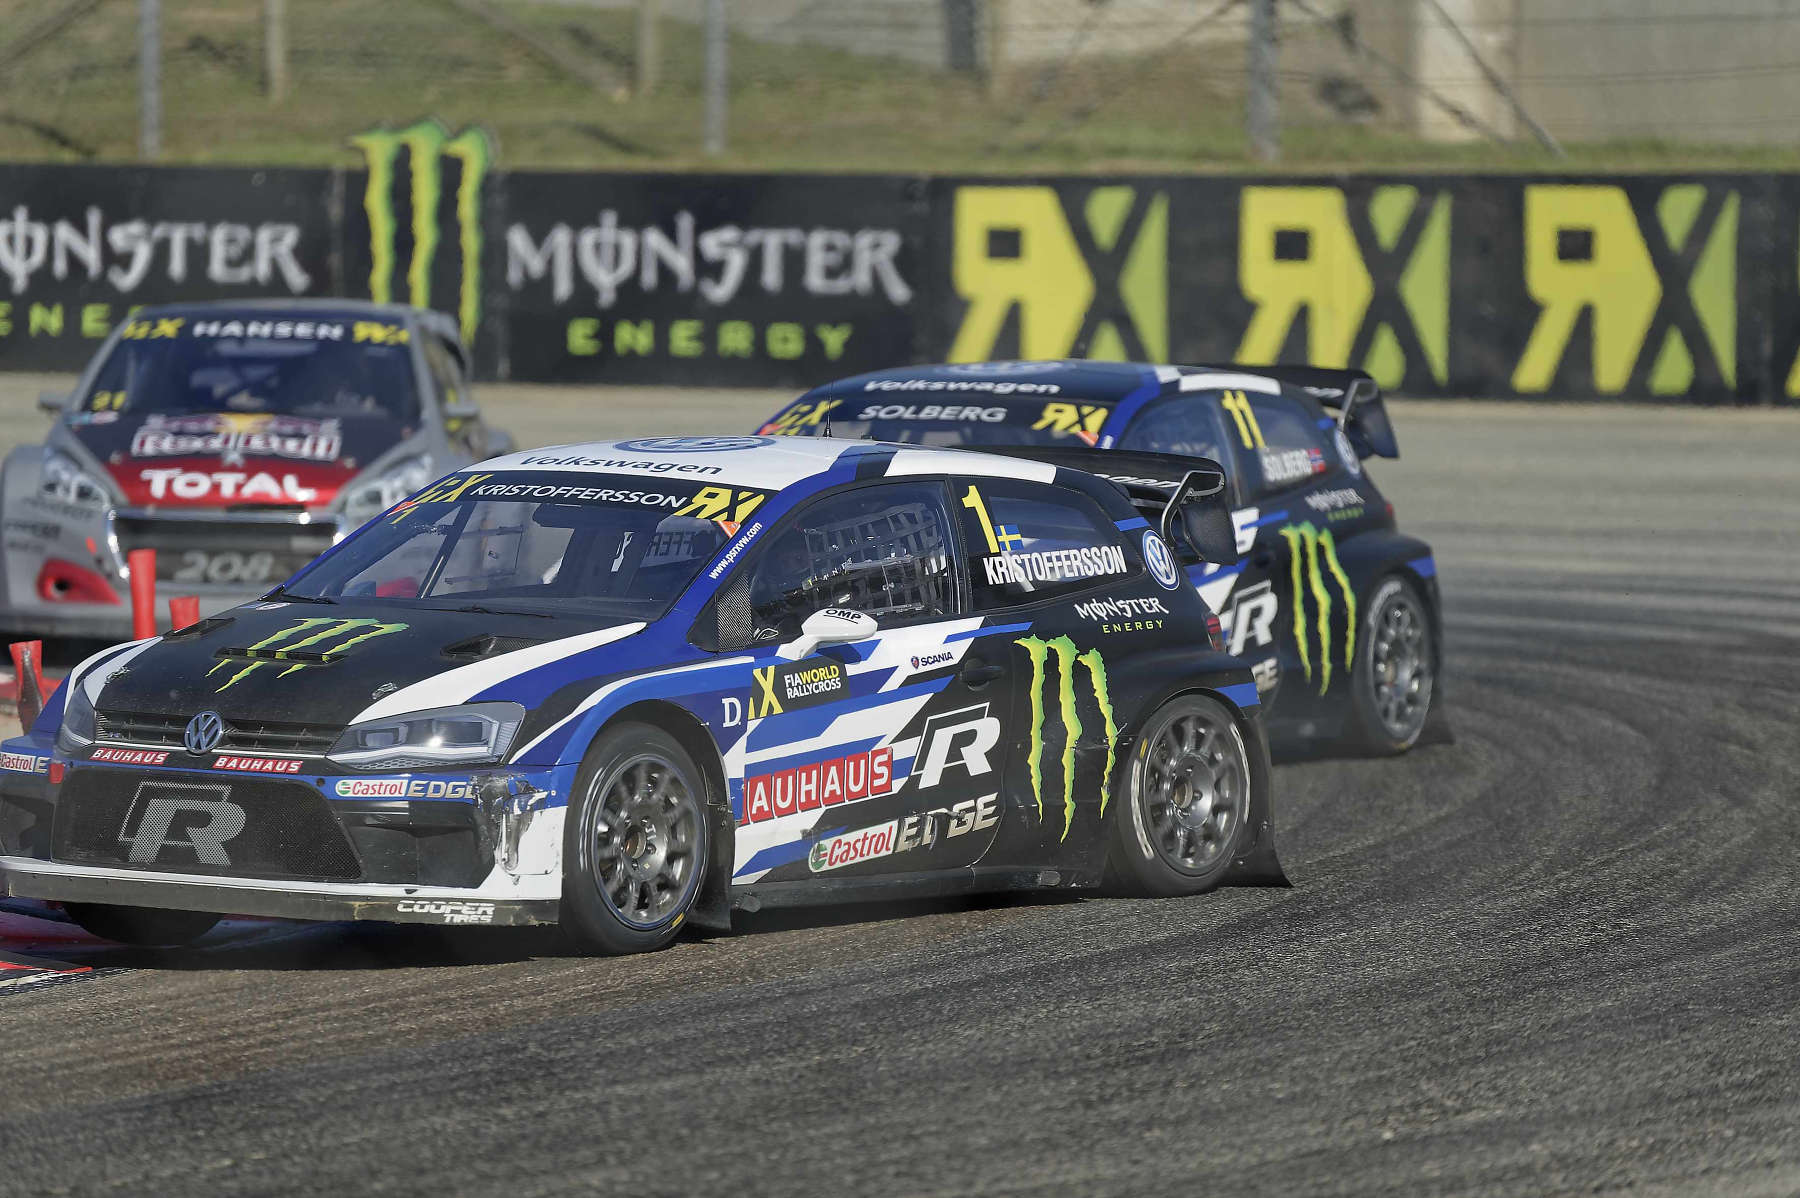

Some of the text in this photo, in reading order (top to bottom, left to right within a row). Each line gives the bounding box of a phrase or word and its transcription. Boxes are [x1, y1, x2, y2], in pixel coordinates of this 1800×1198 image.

[0, 204, 311, 294] ONSTER
[1511, 183, 1740, 395] RX
[192, 320, 344, 341] HANSEN
[567, 317, 853, 360] ENERGY
[864, 380, 1060, 395] Volkswagen
[858, 404, 1007, 423] SOLBERG
[520, 456, 724, 475] Volkswagen
[140, 468, 317, 501] TOTAL
[470, 484, 687, 508] KRISTOFFERSSON
[961, 485, 1000, 554] 1
[708, 521, 763, 580] www.psrxvw.com
[982, 545, 1128, 585] KRISTOFFERSSON
[825, 608, 862, 621] OMP
[1102, 618, 1164, 634] ENERGY
[920, 651, 954, 667] SCANIA
[786, 677, 842, 700] RALLYCROSS
[91, 749, 167, 764] BAUHAUS
[215, 756, 301, 773] BAUHAUS
[351, 780, 404, 796] Castrol
[748, 751, 890, 816] AUHAUS
[827, 825, 893, 866] Castrol
[396, 900, 496, 915] COOPER
[443, 914, 493, 924] TIRES
